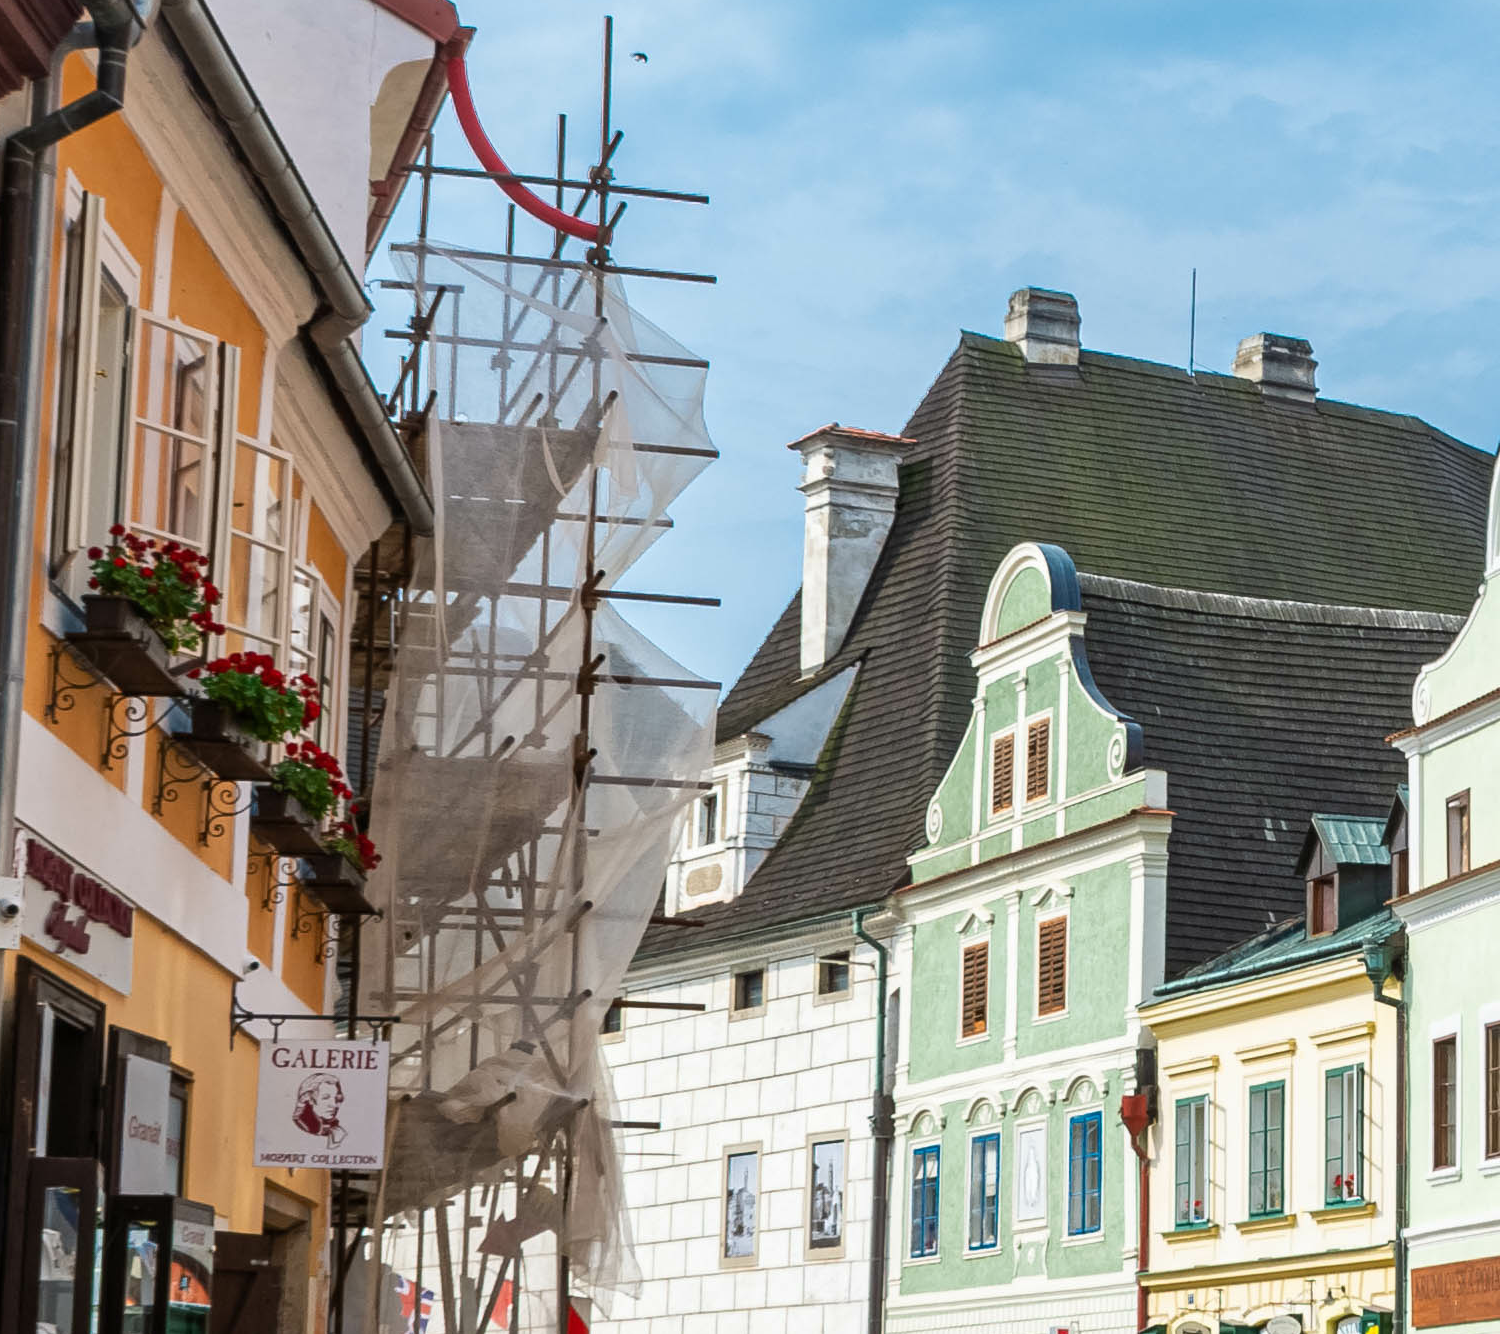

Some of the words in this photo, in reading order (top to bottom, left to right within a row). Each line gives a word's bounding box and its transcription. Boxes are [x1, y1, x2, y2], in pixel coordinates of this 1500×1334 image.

[271, 1047, 380, 1070] GALERIE
[259, 1153, 307, 1164] MOZART
[311, 1154, 378, 1165] COLLECTION
